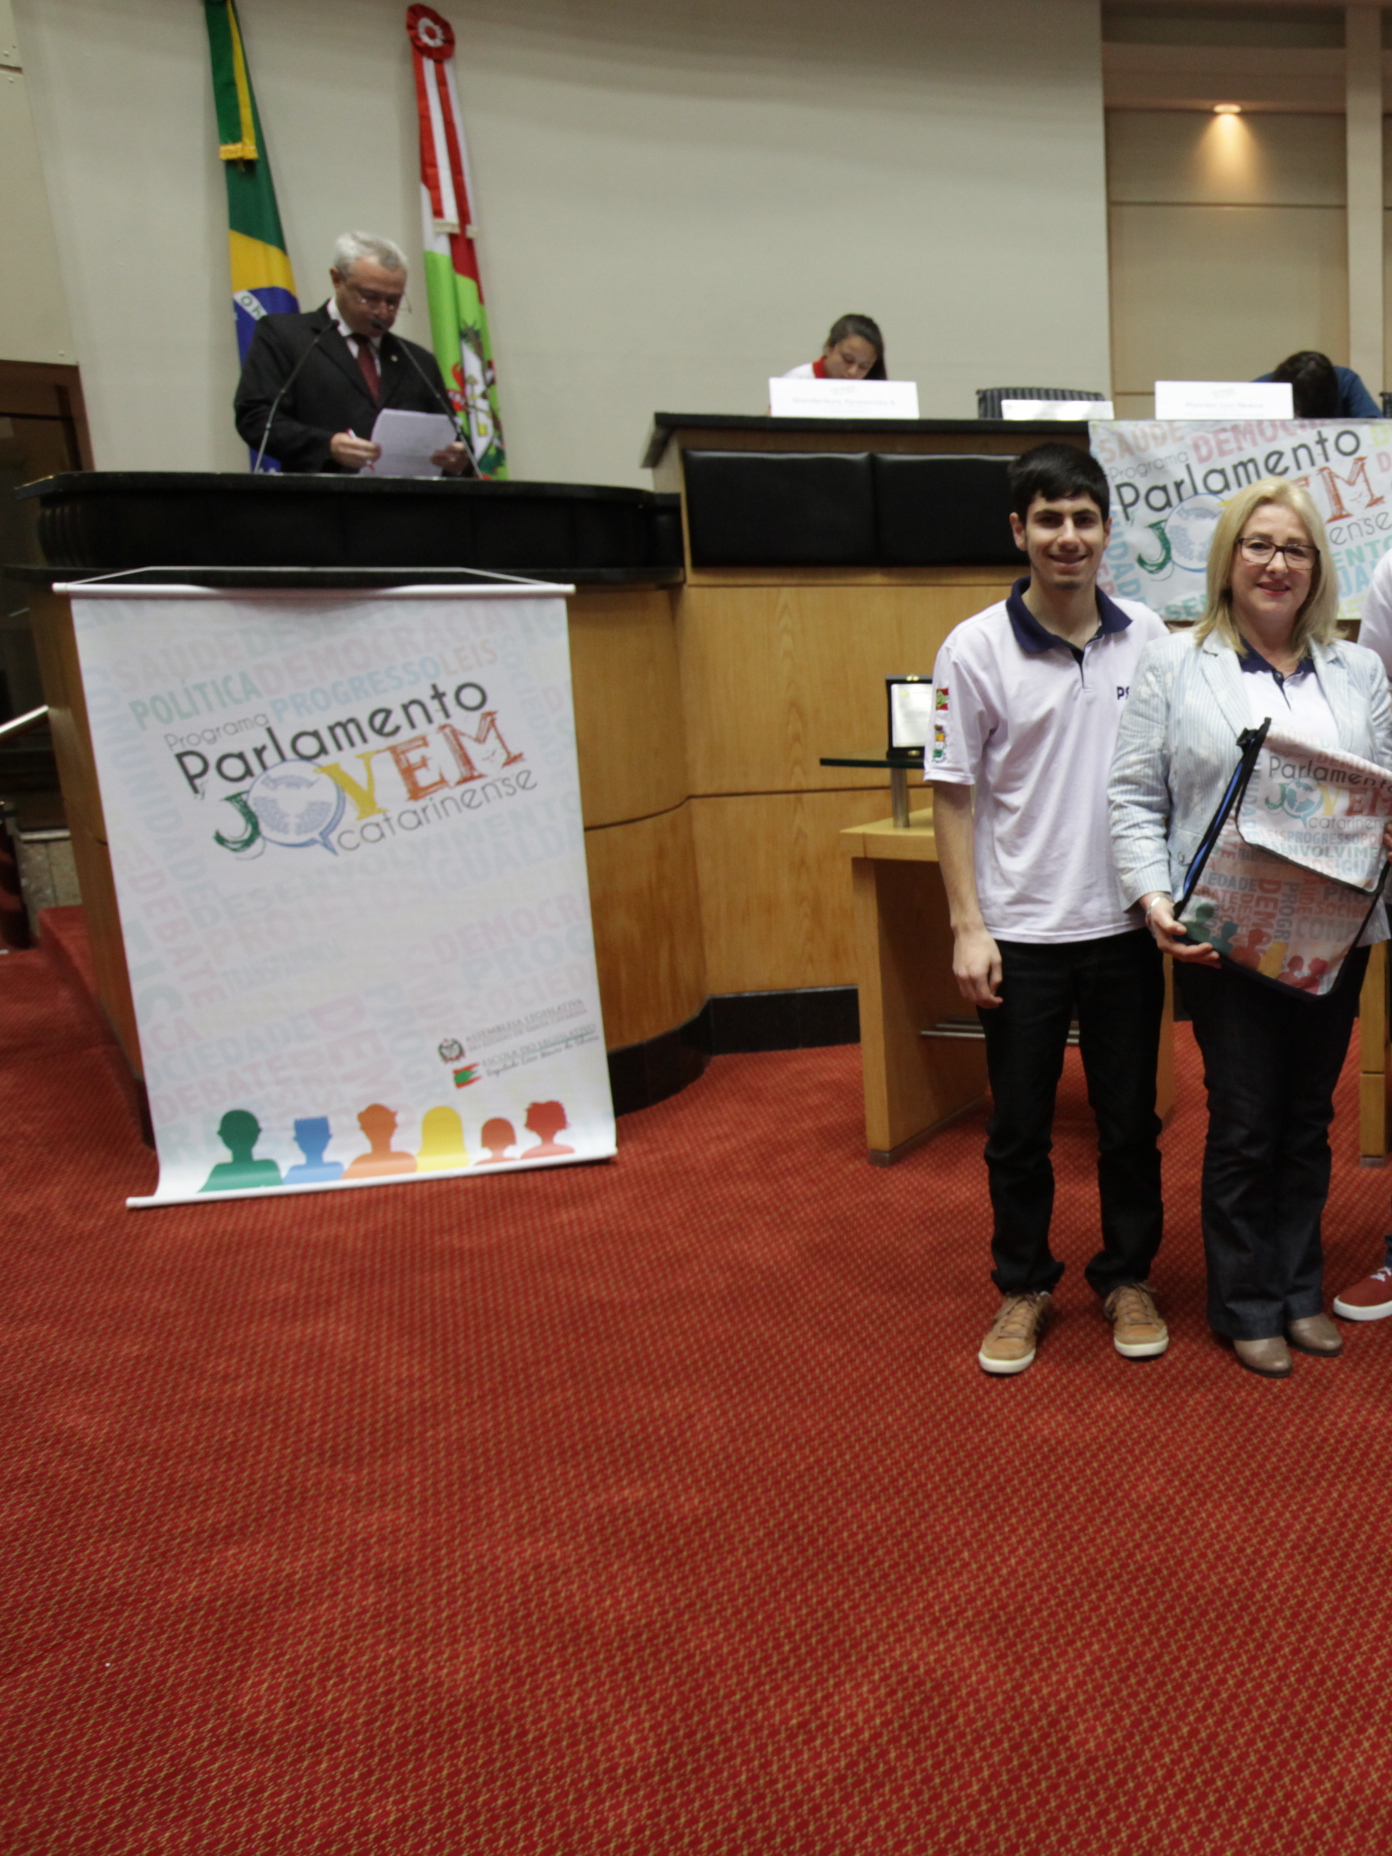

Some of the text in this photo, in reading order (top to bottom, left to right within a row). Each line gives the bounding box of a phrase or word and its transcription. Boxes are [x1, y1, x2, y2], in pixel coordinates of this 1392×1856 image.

[1108, 452, 1189, 483] Programa
[1114, 429, 1362, 522] Parlamento
[253, 604, 513, 696] DEMOCRACIA
[437, 638, 499, 678] LEIS
[128, 671, 263, 731] POLÍTICA
[269, 655, 442, 724] PROGRESSO
[164, 712, 270, 752] Programa
[175, 681, 489, 798] Parlamento
[337, 768, 538, 852] catarinense
[1287, 831, 1360, 845] PROGRESSO
[1308, 816, 1386, 830] catarinen
